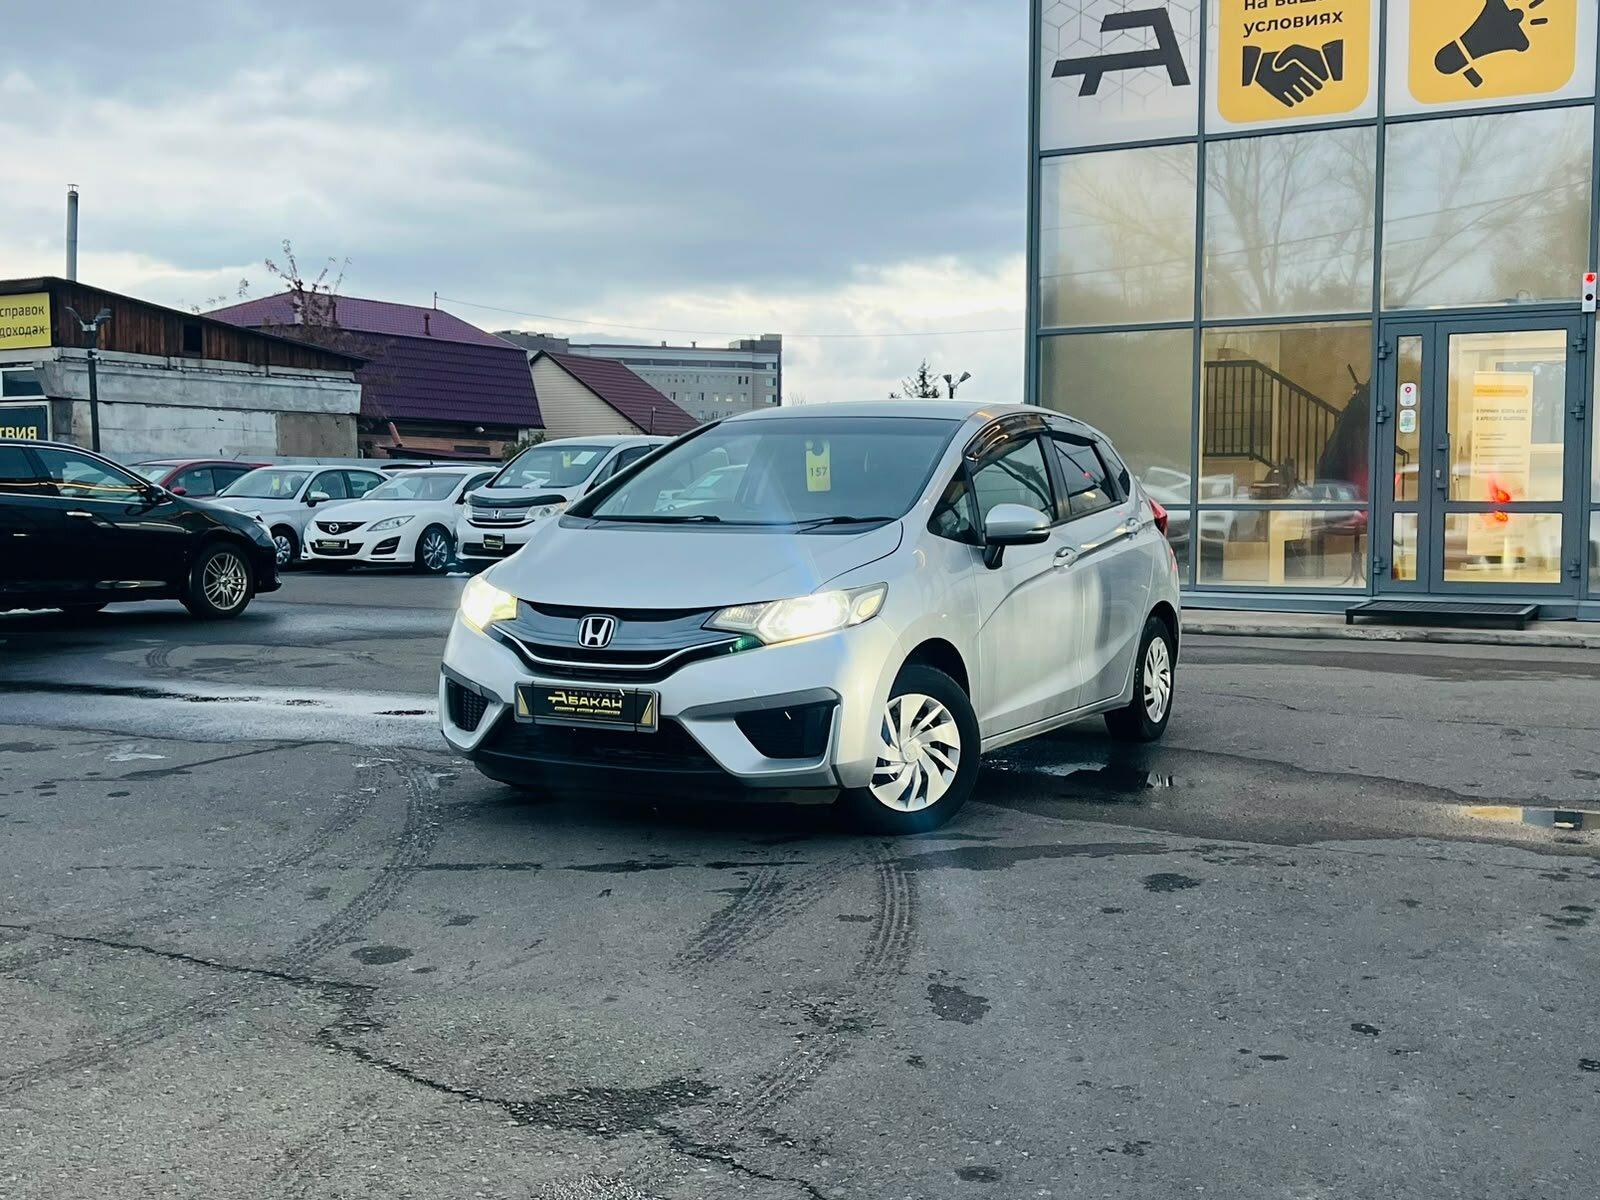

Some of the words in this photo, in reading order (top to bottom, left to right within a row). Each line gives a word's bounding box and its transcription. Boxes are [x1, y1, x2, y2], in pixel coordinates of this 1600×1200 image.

[1243, 11, 1343, 38] условиях
[0, 306, 45, 319] справок
[0, 325, 46, 339] доходах
[810, 466, 828, 477] 157
